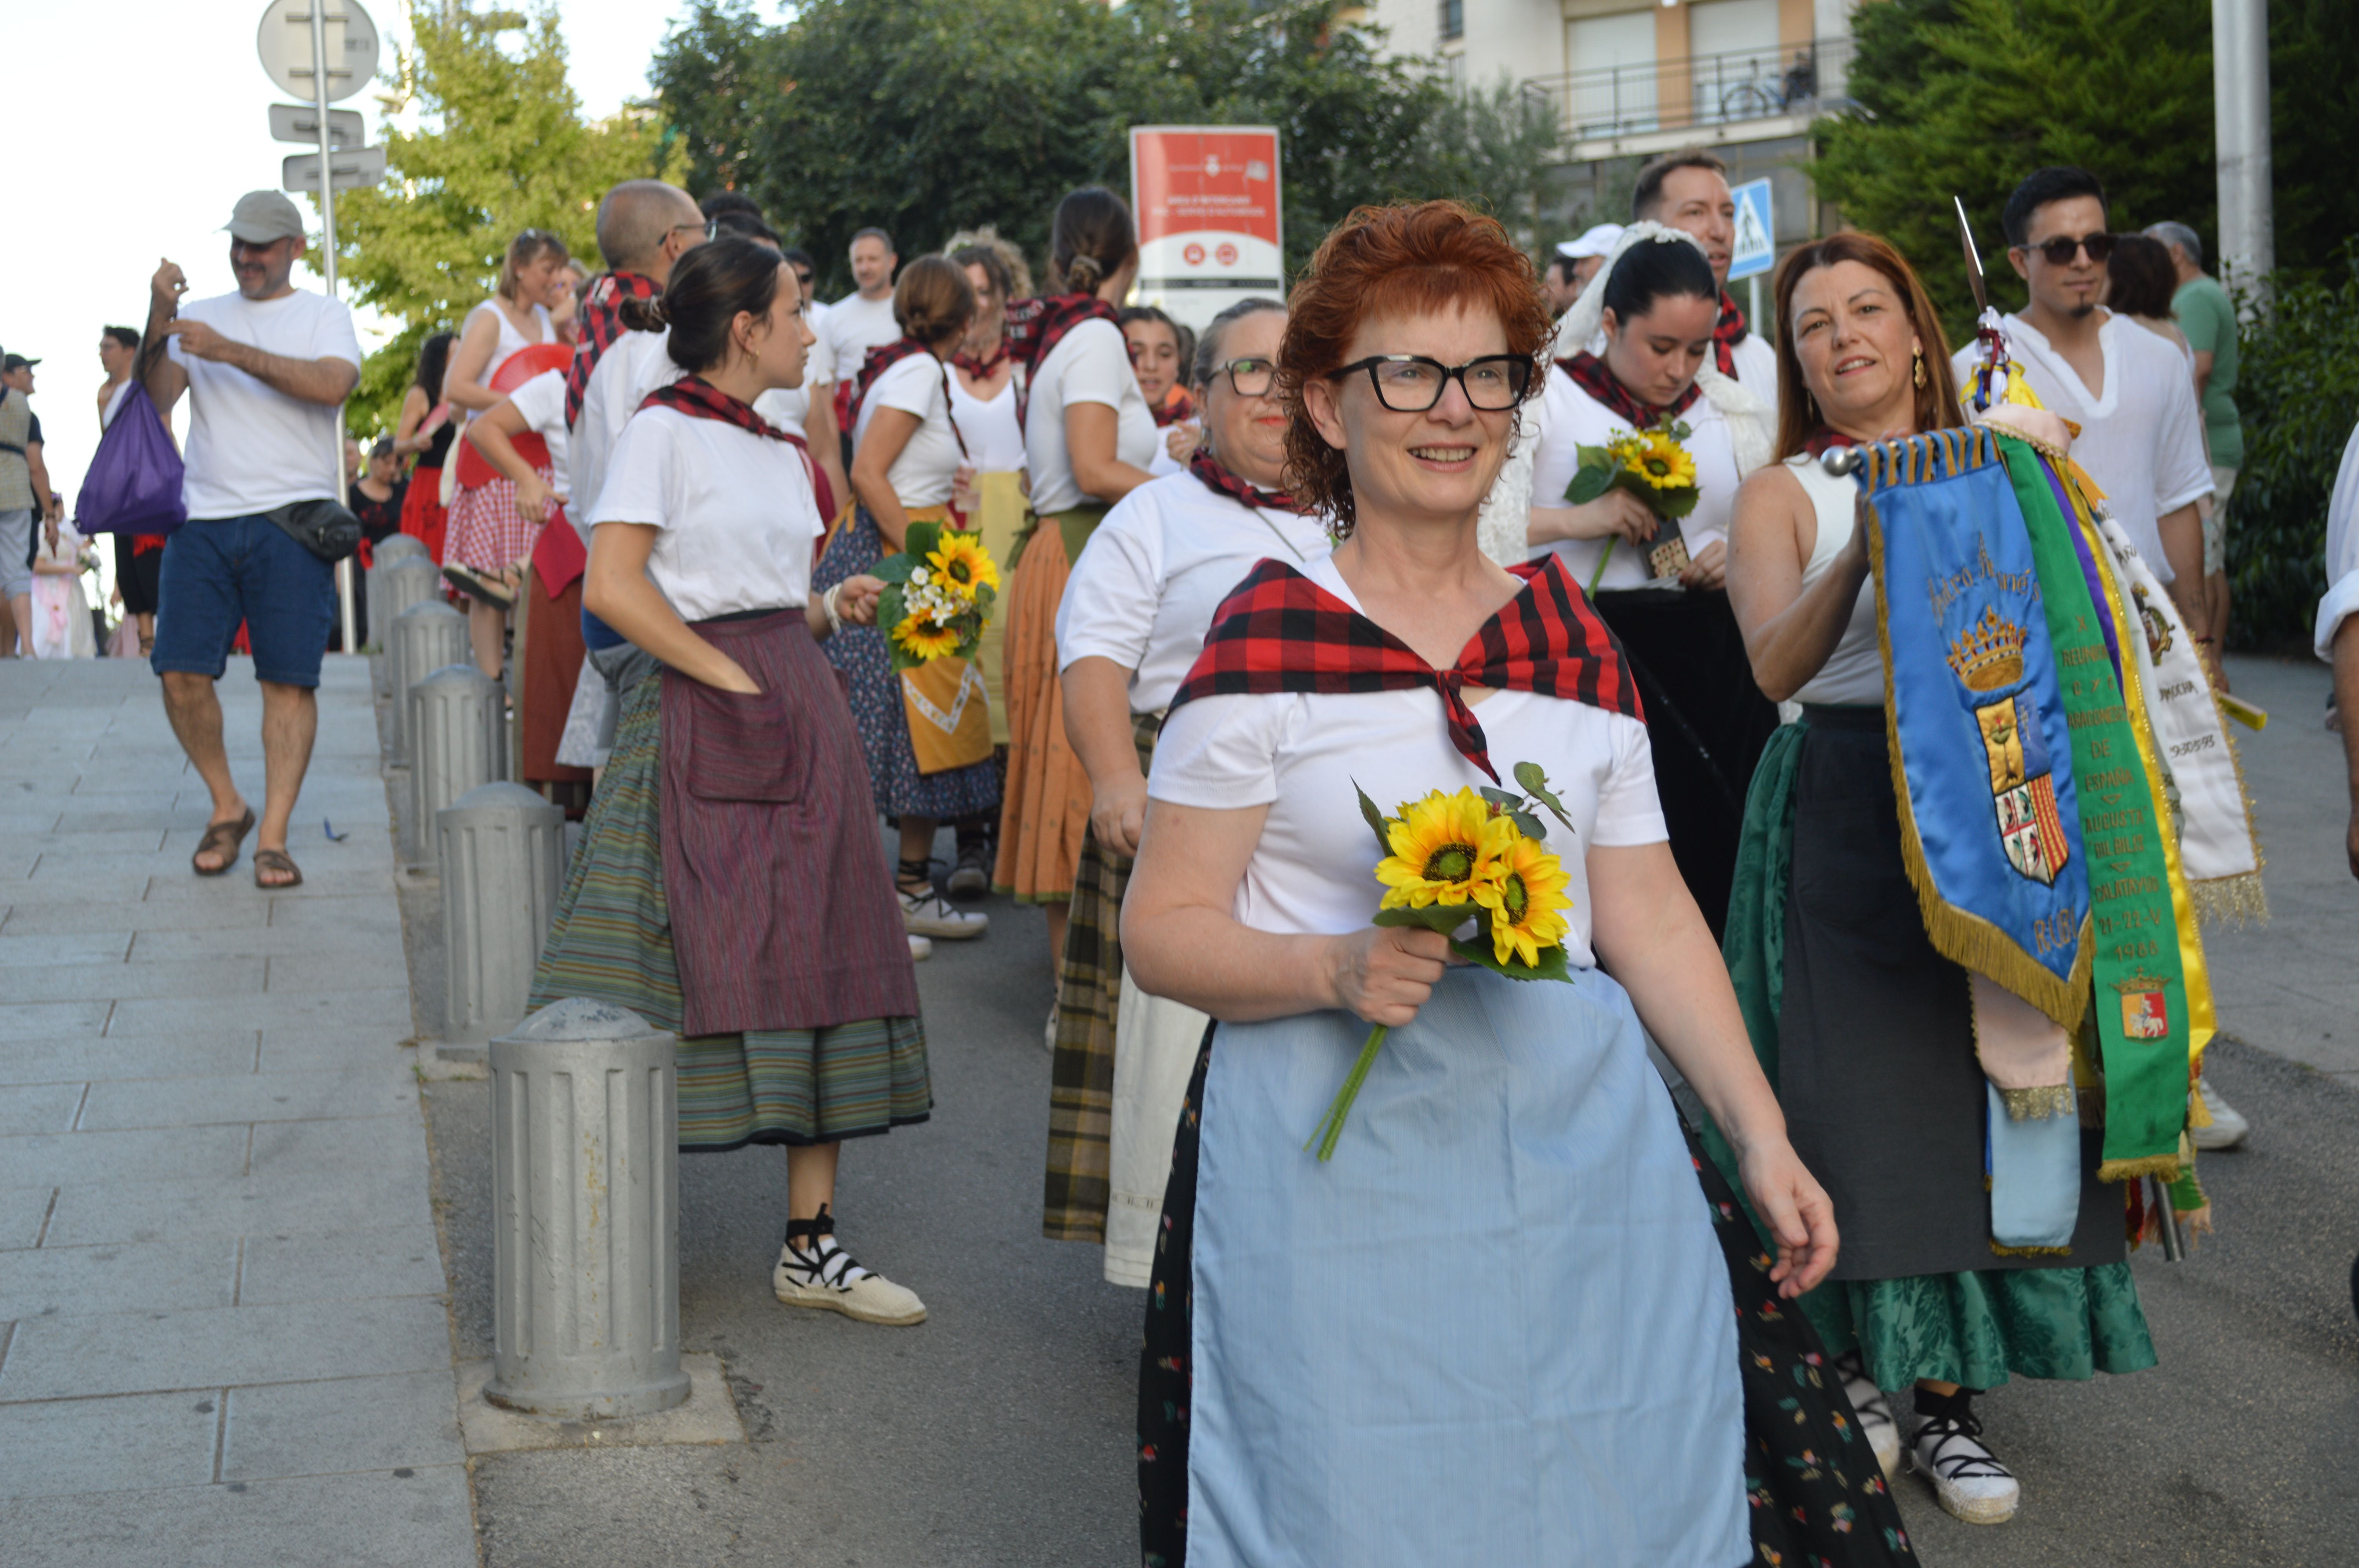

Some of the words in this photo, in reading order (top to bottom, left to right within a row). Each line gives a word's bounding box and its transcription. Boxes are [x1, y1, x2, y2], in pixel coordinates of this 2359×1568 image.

[2091, 739, 2112, 759] DE
[2085, 766, 2134, 792] ESPAÑA
[2114, 939, 2159, 963] 1988
